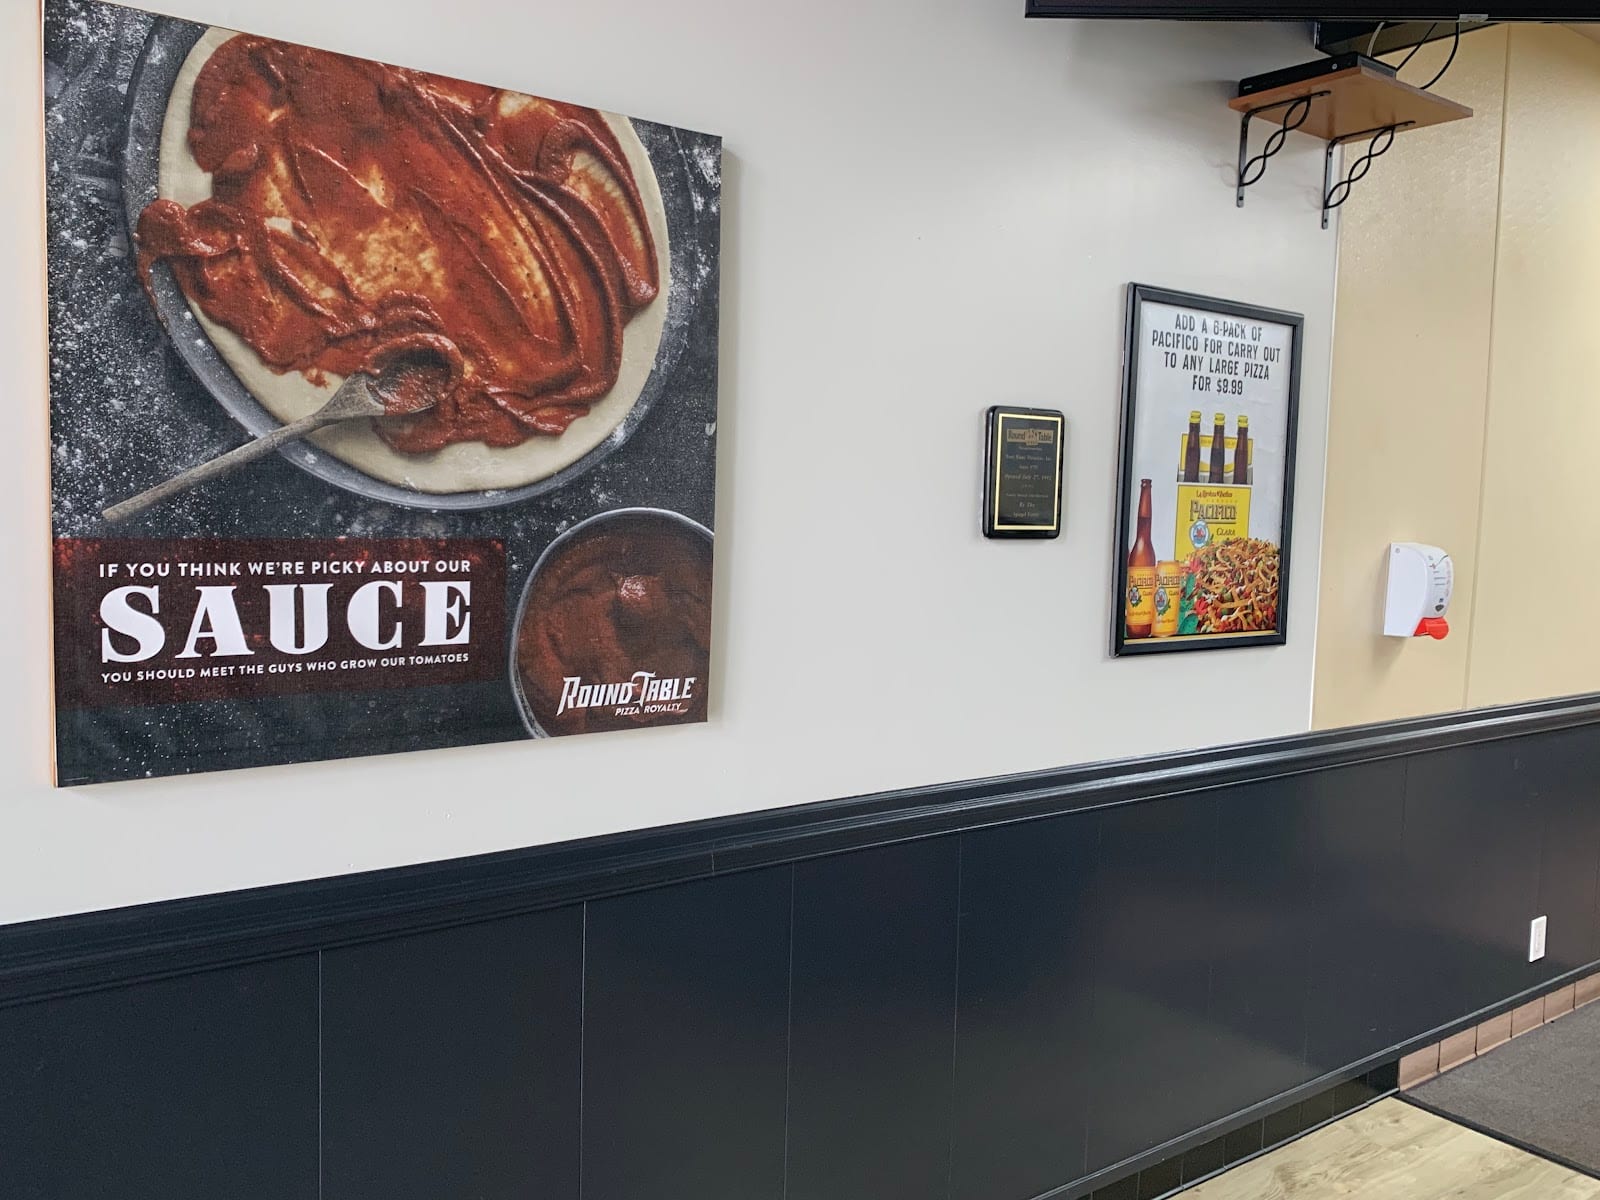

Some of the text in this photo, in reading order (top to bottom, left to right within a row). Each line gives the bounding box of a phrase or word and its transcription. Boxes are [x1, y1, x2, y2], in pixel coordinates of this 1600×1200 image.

[1175, 314, 1262, 342] ADD A 6-PACK OF
[1152, 330, 1280, 363] PACIFICO FOR CARRY OUT
[1164, 352, 1269, 380] TO ANY LARGE PIZZA
[1192, 375, 1211, 391] FOR
[100, 560, 470, 577] IF YOU THINK WE'RE PICKY ABOUT OUR
[100, 580, 471, 663] SAUCE
[101, 653, 469, 683] YOU SHOULD MEET THE GUYS WHO GROW OUR TOMATOES
[615, 703, 682, 716] PIZZA ROYALTY
